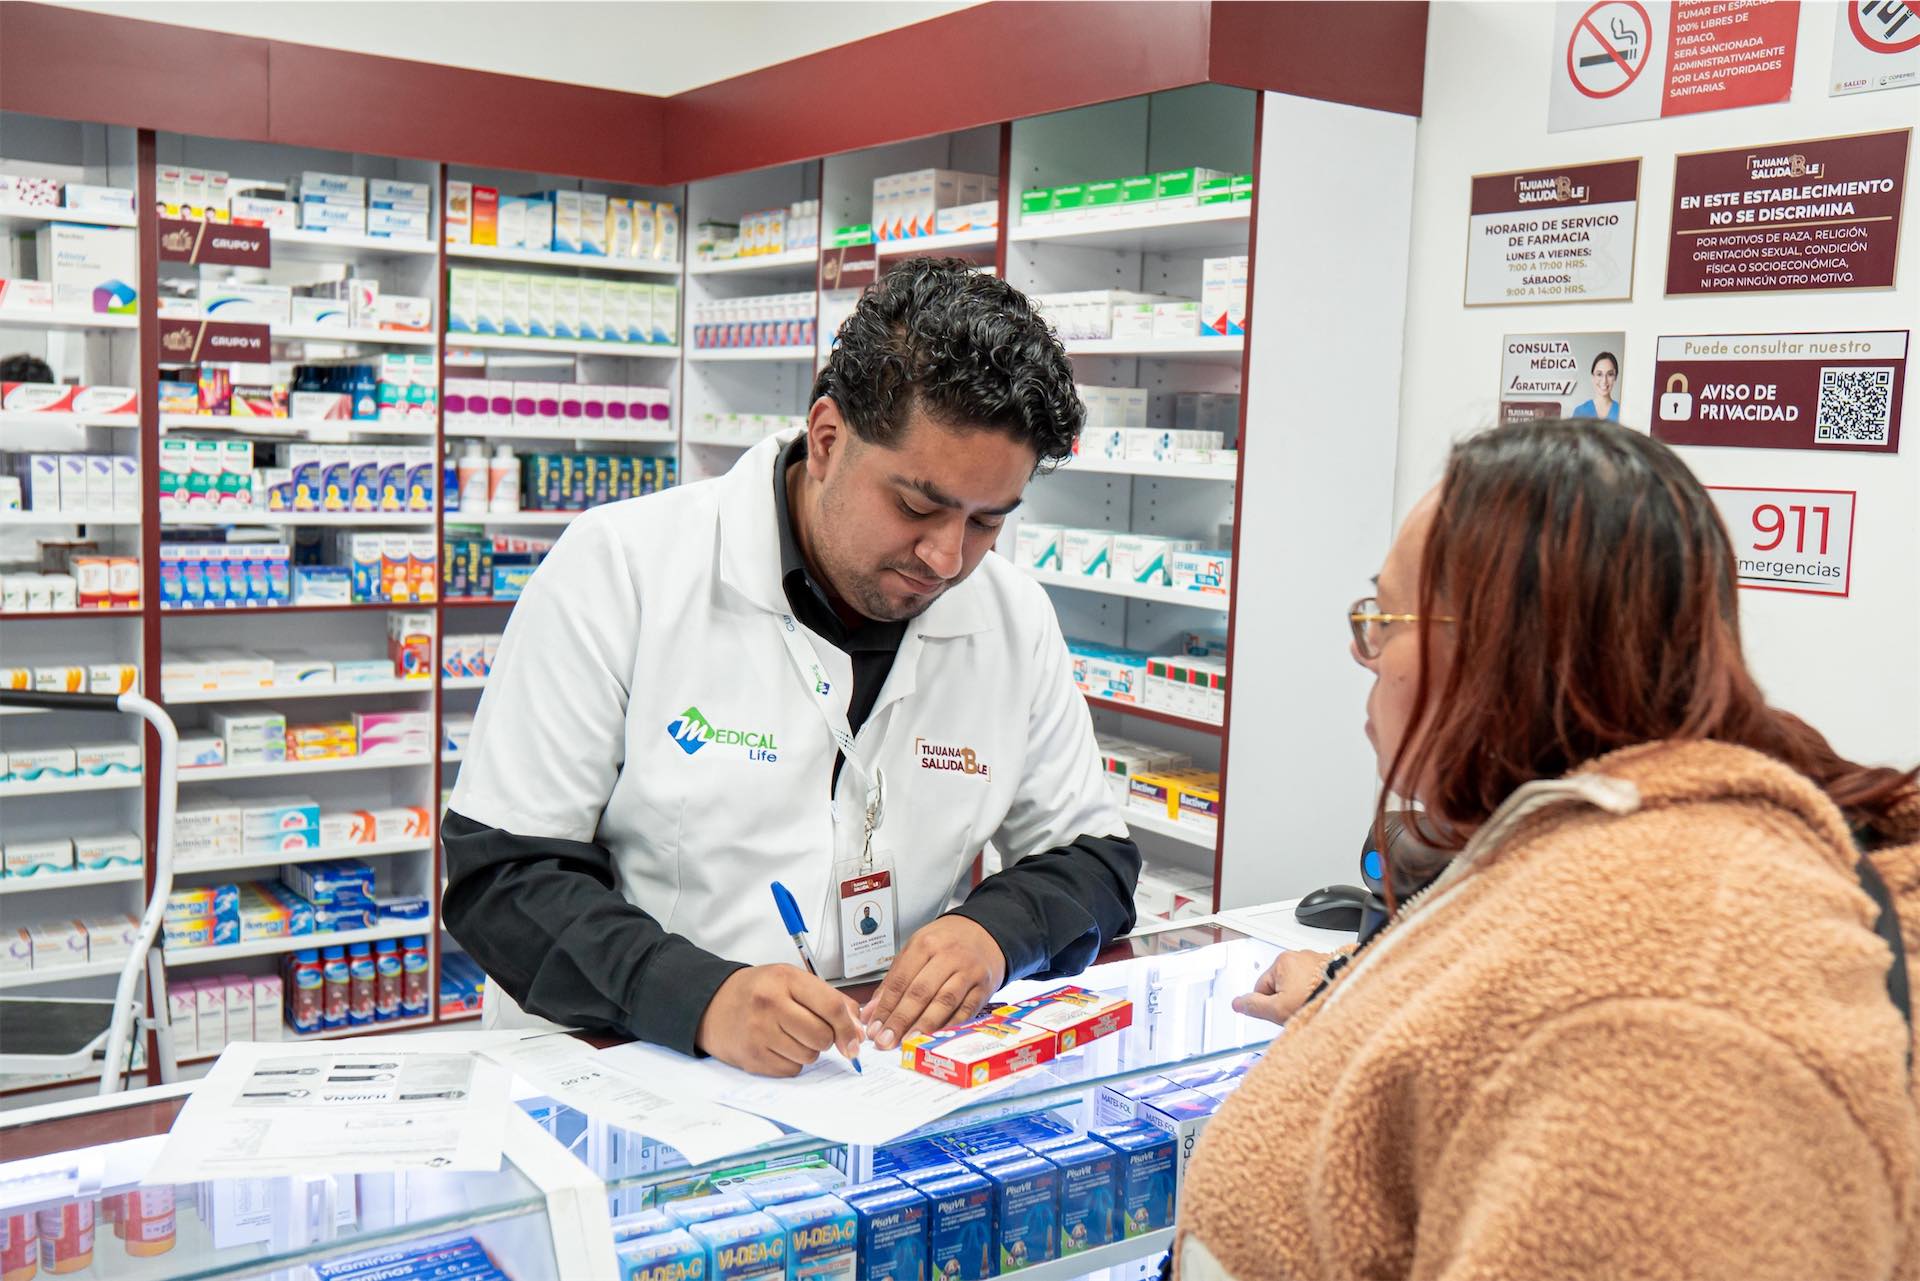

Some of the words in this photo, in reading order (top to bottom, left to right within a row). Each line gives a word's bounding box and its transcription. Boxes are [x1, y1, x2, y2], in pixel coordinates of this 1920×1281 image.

[1678, 7, 1711, 20] FUMAR
[1712, 4, 1726, 14] EN
[1728, 1, 1776, 11] ESPACI
[1677, 22, 1699, 33] 100%
[1700, 15, 1733, 29] LIBRES
[1735, 12, 1749, 22] DE
[1676, 32, 1715, 46] TABACO,
[1674, 46, 1698, 59] SERÁ
[1699, 36, 1763, 55] SANCIONADA
[1673, 46, 1785, 72] ADMINISTRATIVAMENTE
[1671, 73, 1692, 85] POR
[1693, 70, 1710, 81] LAS
[1711, 60, 1782, 79] AUTORIDADES
[1670, 82, 1726, 97] SANITARIAS.
[1751, 156, 1790, 169] TIJUANA
[1519, 178, 1556, 192] TIJUANA
[1680, 196, 1701, 209] EN
[1703, 193, 1740, 208] ESTE
[1743, 178, 1894, 204] ESTABLECIMIENTO
[1709, 210, 1732, 225] NO
[1735, 208, 1755, 223] SE
[1758, 201, 1856, 222] DISCRIMINA
[1485, 222, 1538, 236] HORARIO
[1542, 220, 1558, 231] DE
[1561, 215, 1619, 230] SERVICIO
[212, 238, 250, 251] GRUPO
[251, 241, 260, 251] V
[1508, 237, 1524, 247] DE
[1527, 231, 1590, 245] FARMACIA
[1696, 236, 1717, 248] POR
[1719, 232, 1764, 246] MOTIVOS
[1767, 232, 1781, 243] DE
[1783, 229, 1812, 242] RAZA,
[1814, 226, 1868, 239] RELIGIÓN,
[1506, 250, 1536, 261] LUNES
[1538, 250, 1546, 259] A
[1548, 248, 1592, 258] VIERNES:
[1692, 247, 1760, 262] ORIENTACIÓN
[1761, 246, 1803, 258] SEXUAL,
[1804, 241, 1868, 255] CONDICIÓN
[1508, 262, 1528, 272] 7:00
[1530, 261, 1537, 270] A
[1540, 260, 1563, 270] 17:00
[1565, 259, 1587, 269] HRS.
[1706, 260, 1736, 274] FÍSICA
[1738, 263, 1747, 272] O
[1748, 258, 1850, 272] SOCIOECONÓMICA,
[1522, 274, 1572, 285] SÁBADOS:
[1701, 277, 1712, 288] NI
[1713, 276, 1735, 288] POR
[1736, 272, 1776, 286] NINGÚN
[1778, 274, 1808, 285] OTRO
[1810, 271, 1855, 284] MOTIVO.
[1506, 287, 1526, 297] 9:00
[1528, 287, 1536, 295] A
[1538, 286, 1562, 296] 14:00
[1564, 284, 1587, 295] HRS.
[211, 336, 248, 347] GRUPO
[1508, 342, 1569, 354] CONSULTA
[1684, 341, 1728, 355] Puede
[1732, 340, 1804, 355] consultar
[1809, 341, 1872, 353] nuestro
[1530, 356, 1576, 370] MÉDICA
[1700, 384, 1750, 400] AVISO
[1754, 384, 1777, 400] DE
[1700, 404, 1799, 422] PRIVACIDAD
[1751, 503, 1830, 555] 911
[1738, 557, 1841, 579] mergencias
[749, 749, 777, 763] Life
[921, 744, 962, 758] TIJUANA
[1066, 1166, 1092, 1179] PisaVit
[1006, 1181, 1032, 1196] PisaVit
[871, 1214, 900, 1229] PisaVit
[793, 1221, 855, 1250] VI-DEA-C
[717, 1238, 784, 1271] VI-DEA-C
[320, 1253, 404, 1277] vitaminas
